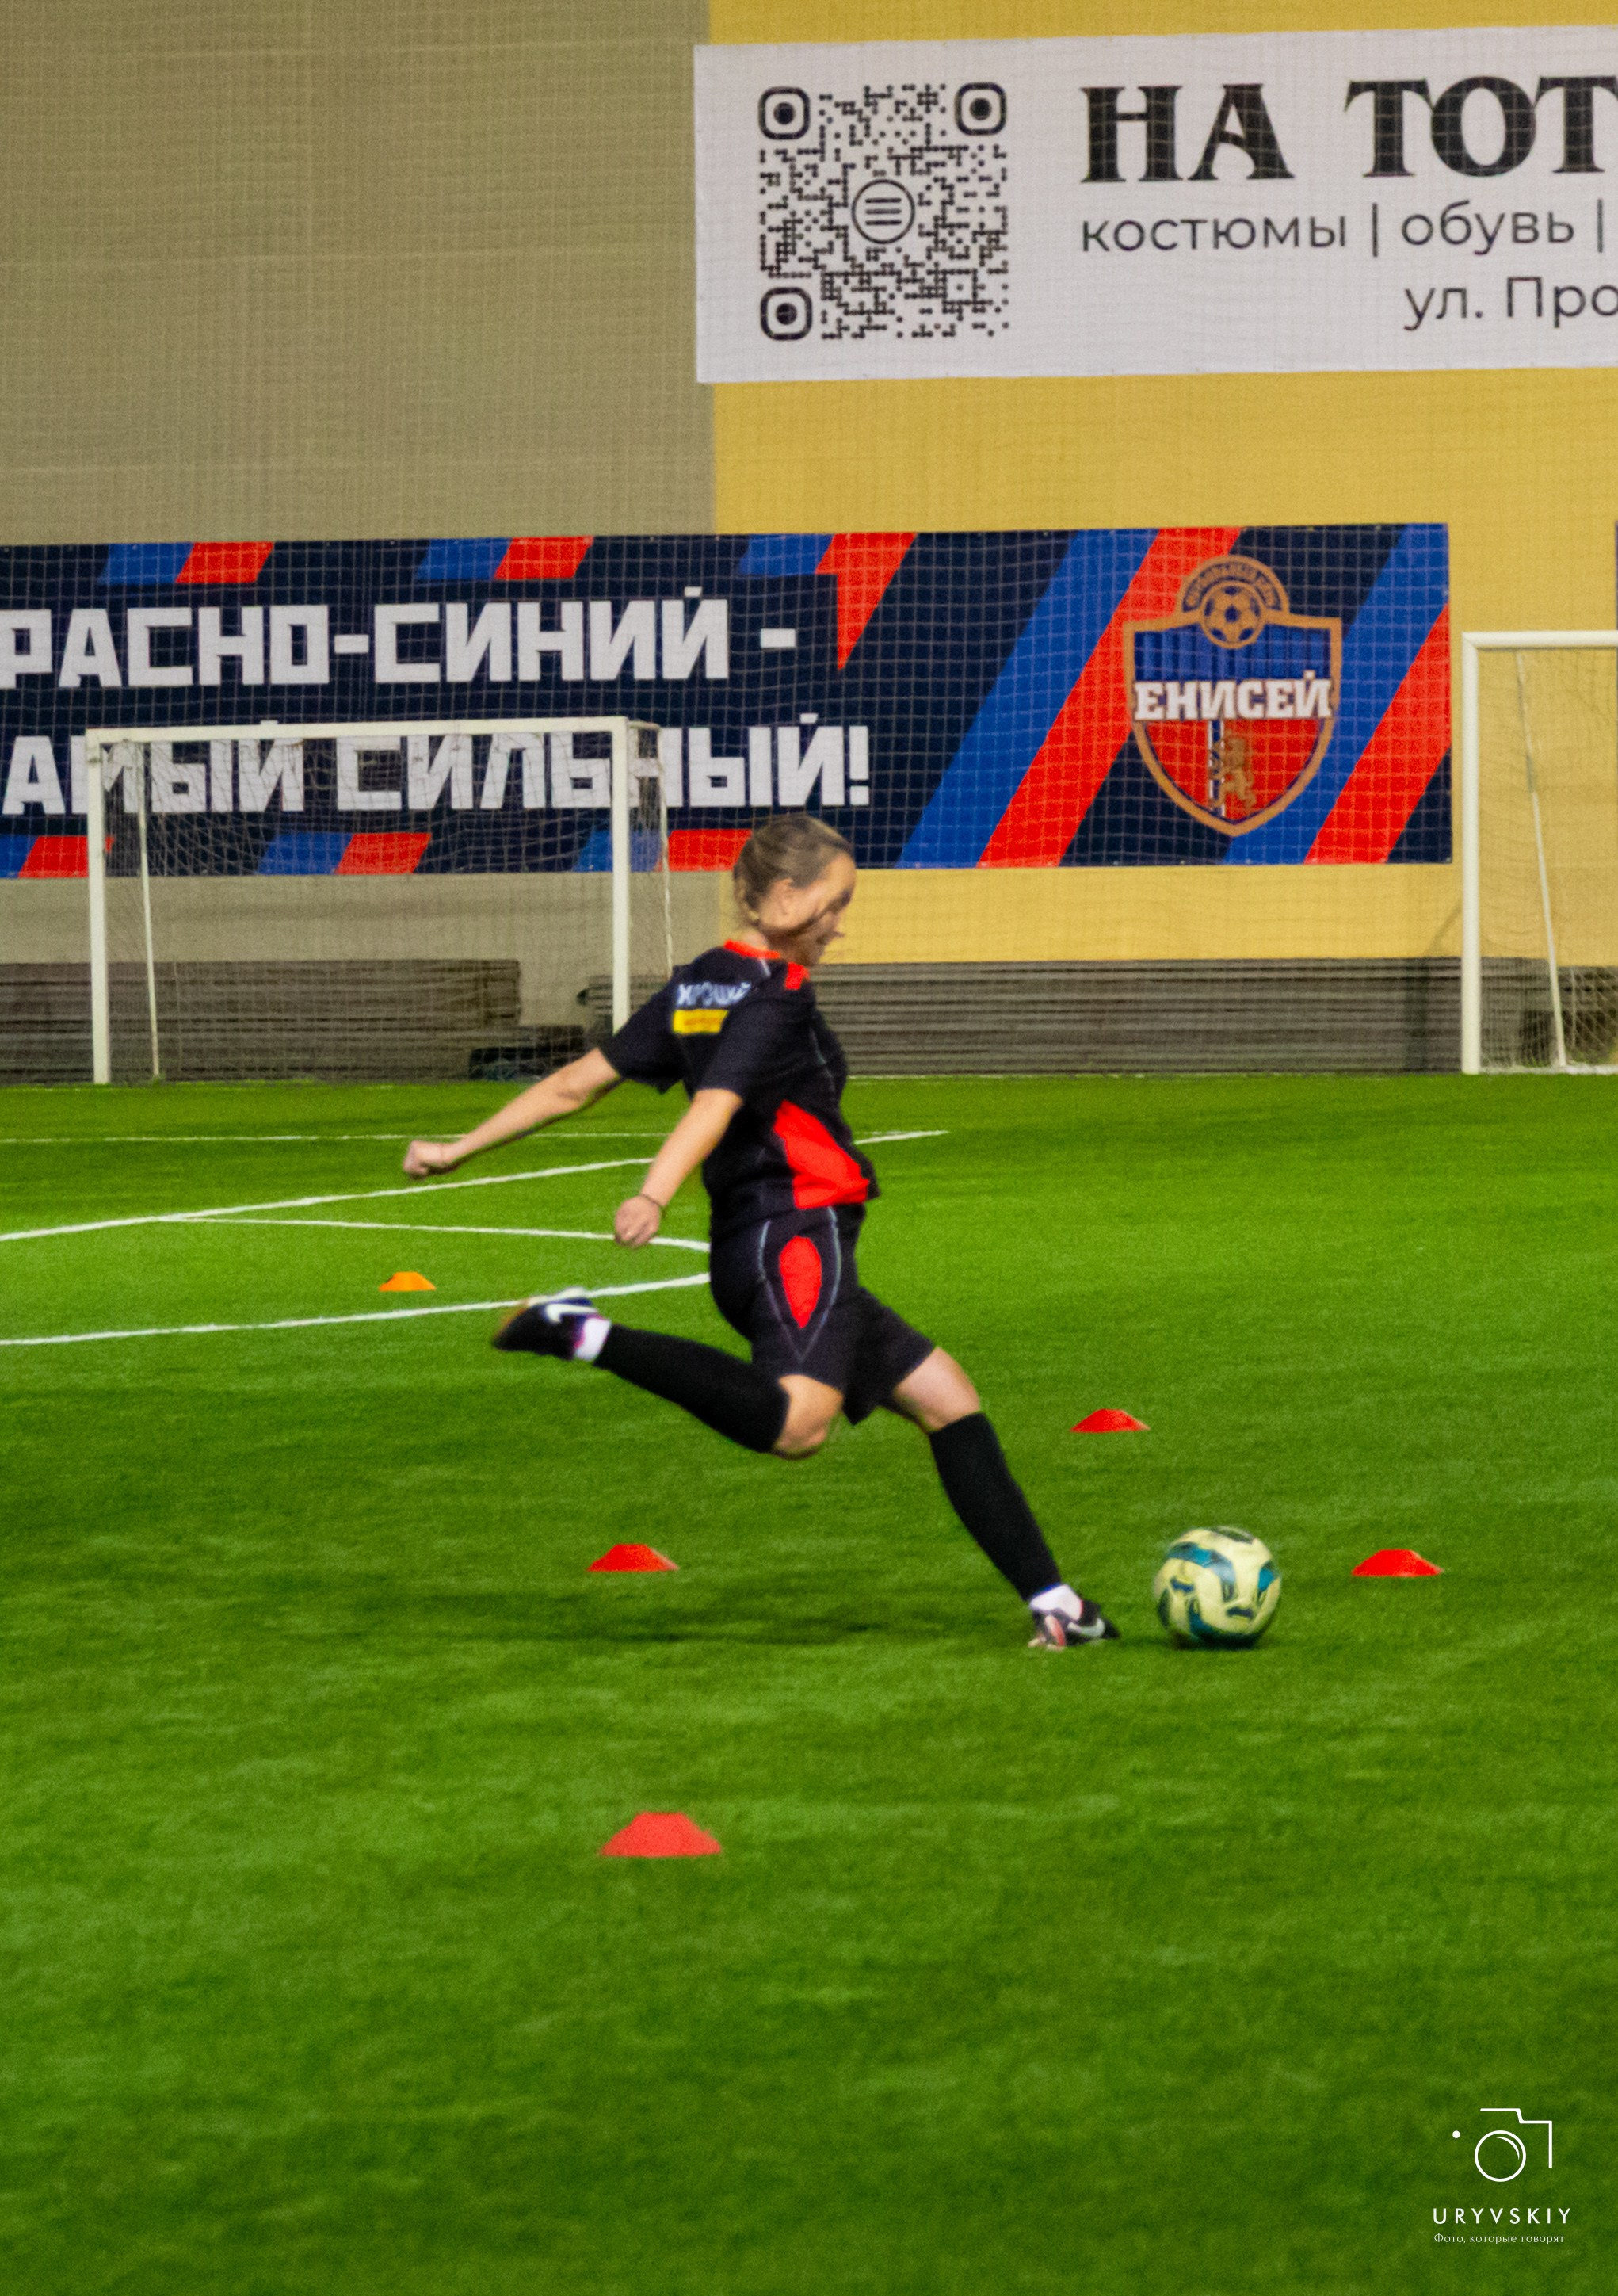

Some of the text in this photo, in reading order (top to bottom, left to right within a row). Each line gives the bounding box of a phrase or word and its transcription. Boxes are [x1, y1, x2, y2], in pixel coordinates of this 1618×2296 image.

[1079, 74, 1618, 184] НА ТОТ
[1082, 216, 1347, 252] костюмы
[1401, 199, 1575, 256] обувь
[1403, 287, 1483, 332] ул.
[1135, 670, 1333, 721] ЕНИСЕЙ
